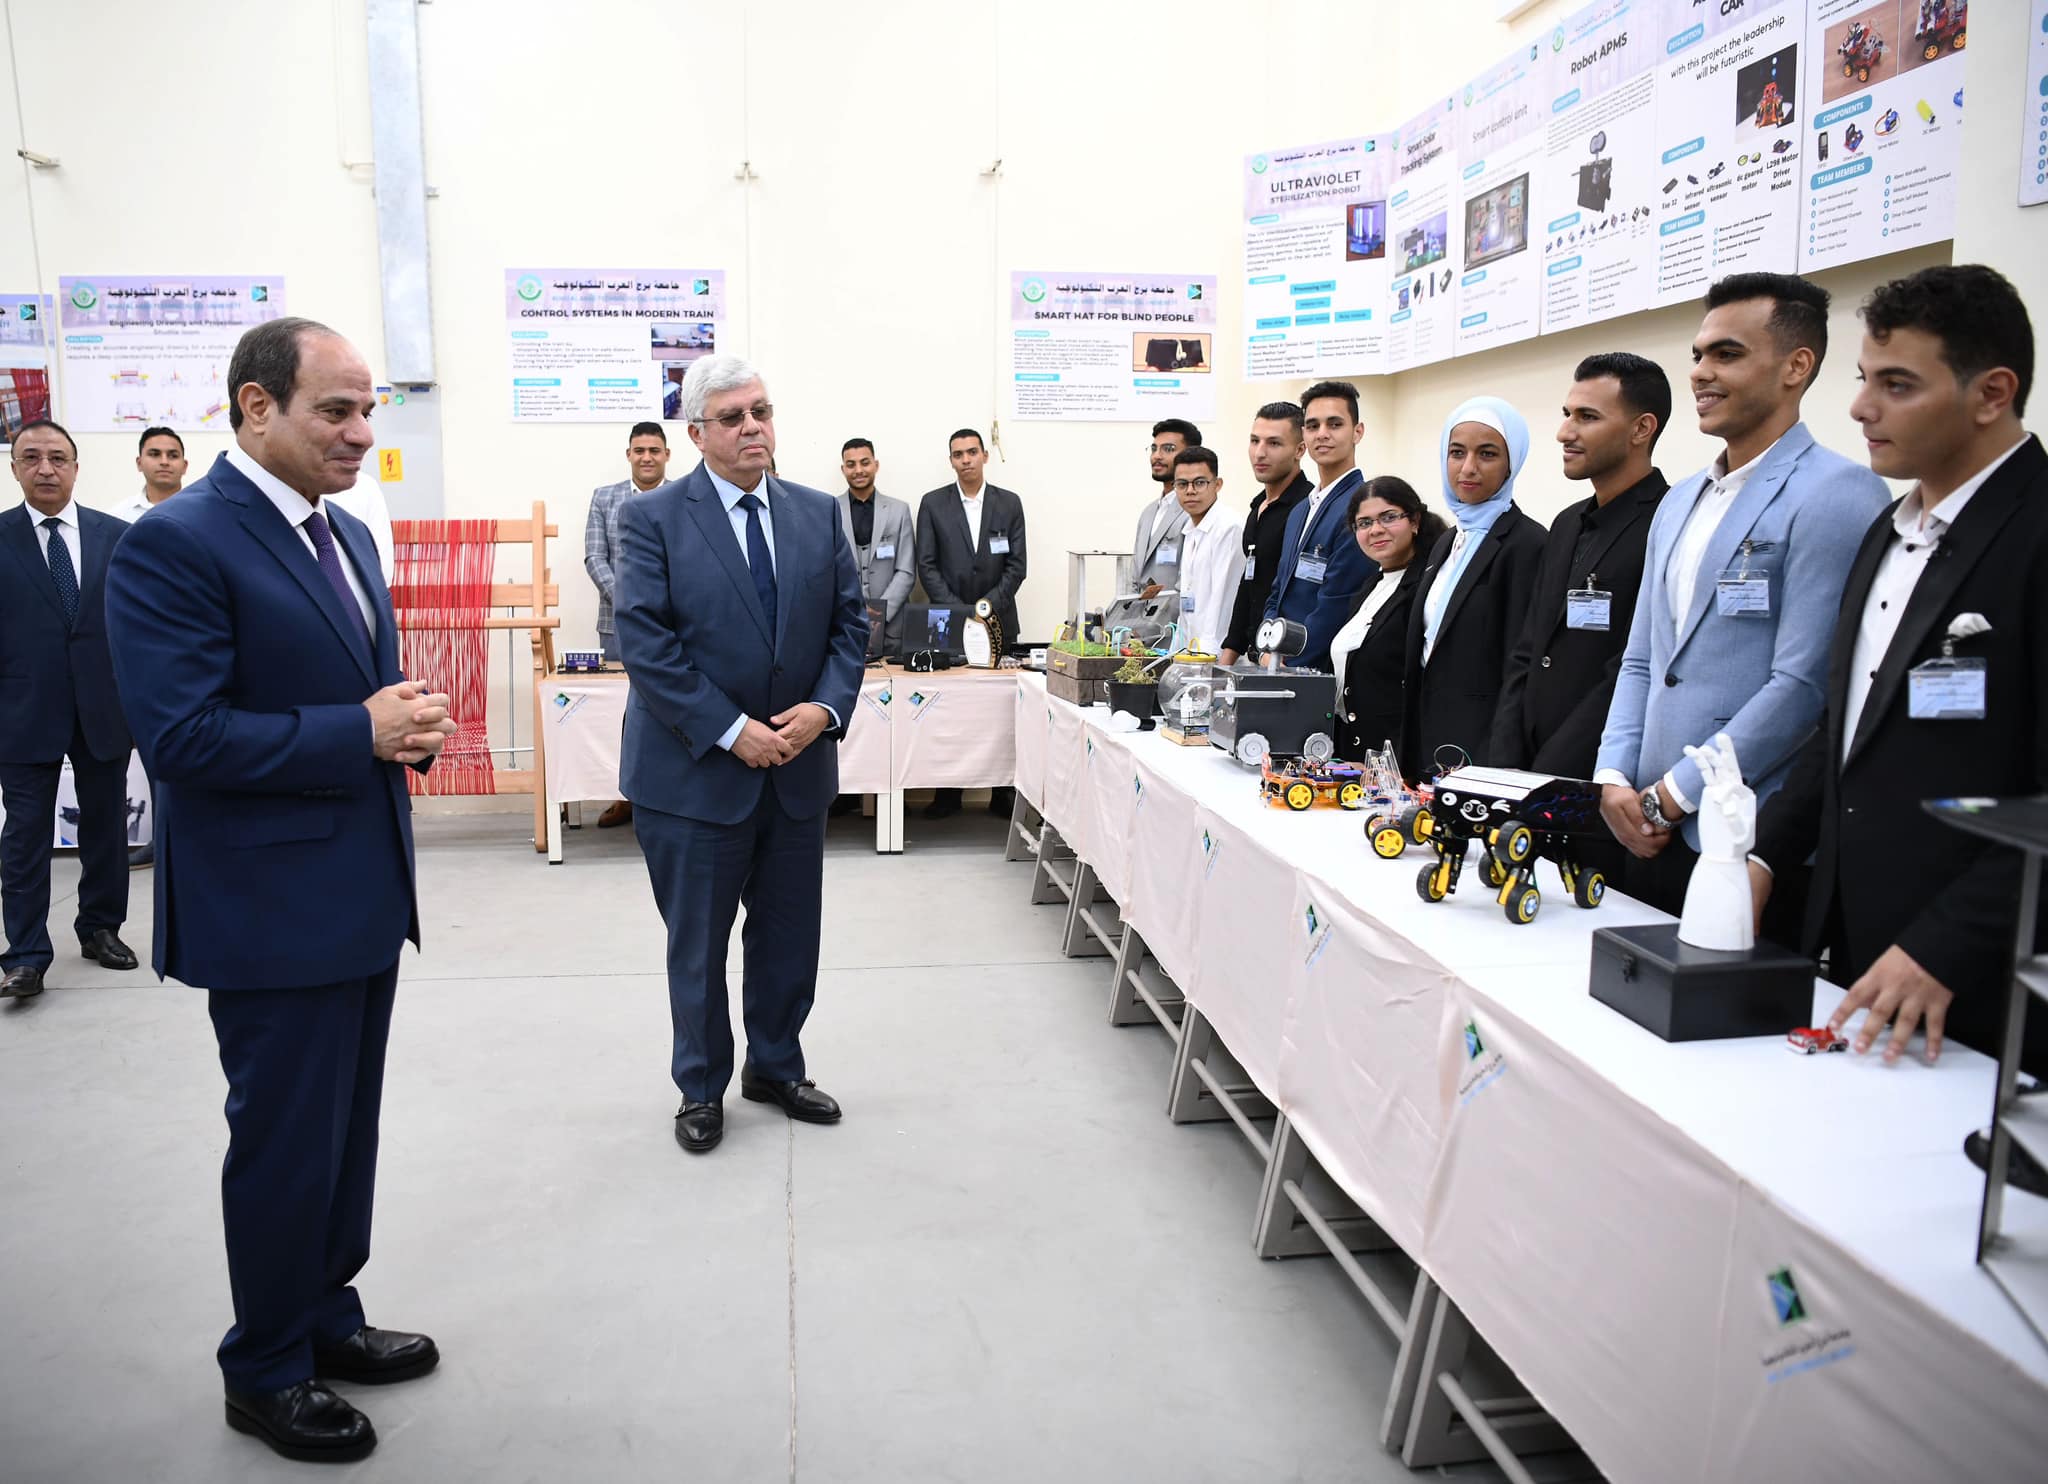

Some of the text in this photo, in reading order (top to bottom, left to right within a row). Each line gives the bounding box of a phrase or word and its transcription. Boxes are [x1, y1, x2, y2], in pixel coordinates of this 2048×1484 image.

[1570, 32, 1628, 75] Robot APMS
[1671, 15, 1785, 78] with this project the leadership
[1696, 46, 1754, 80] will be futuristic
[1823, 101, 1864, 123] COMPONENTS
[1473, 104, 1528, 143] Smart control unit
[1407, 138, 1423, 155] Smart
[1400, 146, 1443, 176] Tracking System
[1781, 153, 1798, 164] Motor
[1271, 170, 1361, 193] ULTRAVIOLET
[1773, 168, 1790, 179] Driver
[1817, 172, 1835, 185] TEAM
[1836, 162, 1865, 178] MEMBERS
[1741, 181, 1757, 192] motor
[1771, 179, 1792, 191] Module
[1271, 185, 1361, 205] STERILIZATION ROBOT
[1710, 192, 1728, 203] sensor
[521, 309, 714, 318] CONTROL SYSTEMS IN MODERN TRAIN
[1035, 312, 1194, 322] SMART HAT FOR BLIND PEOPLE
[109, 320, 154, 328] Engineering
[156, 320, 188, 328] Drawing
